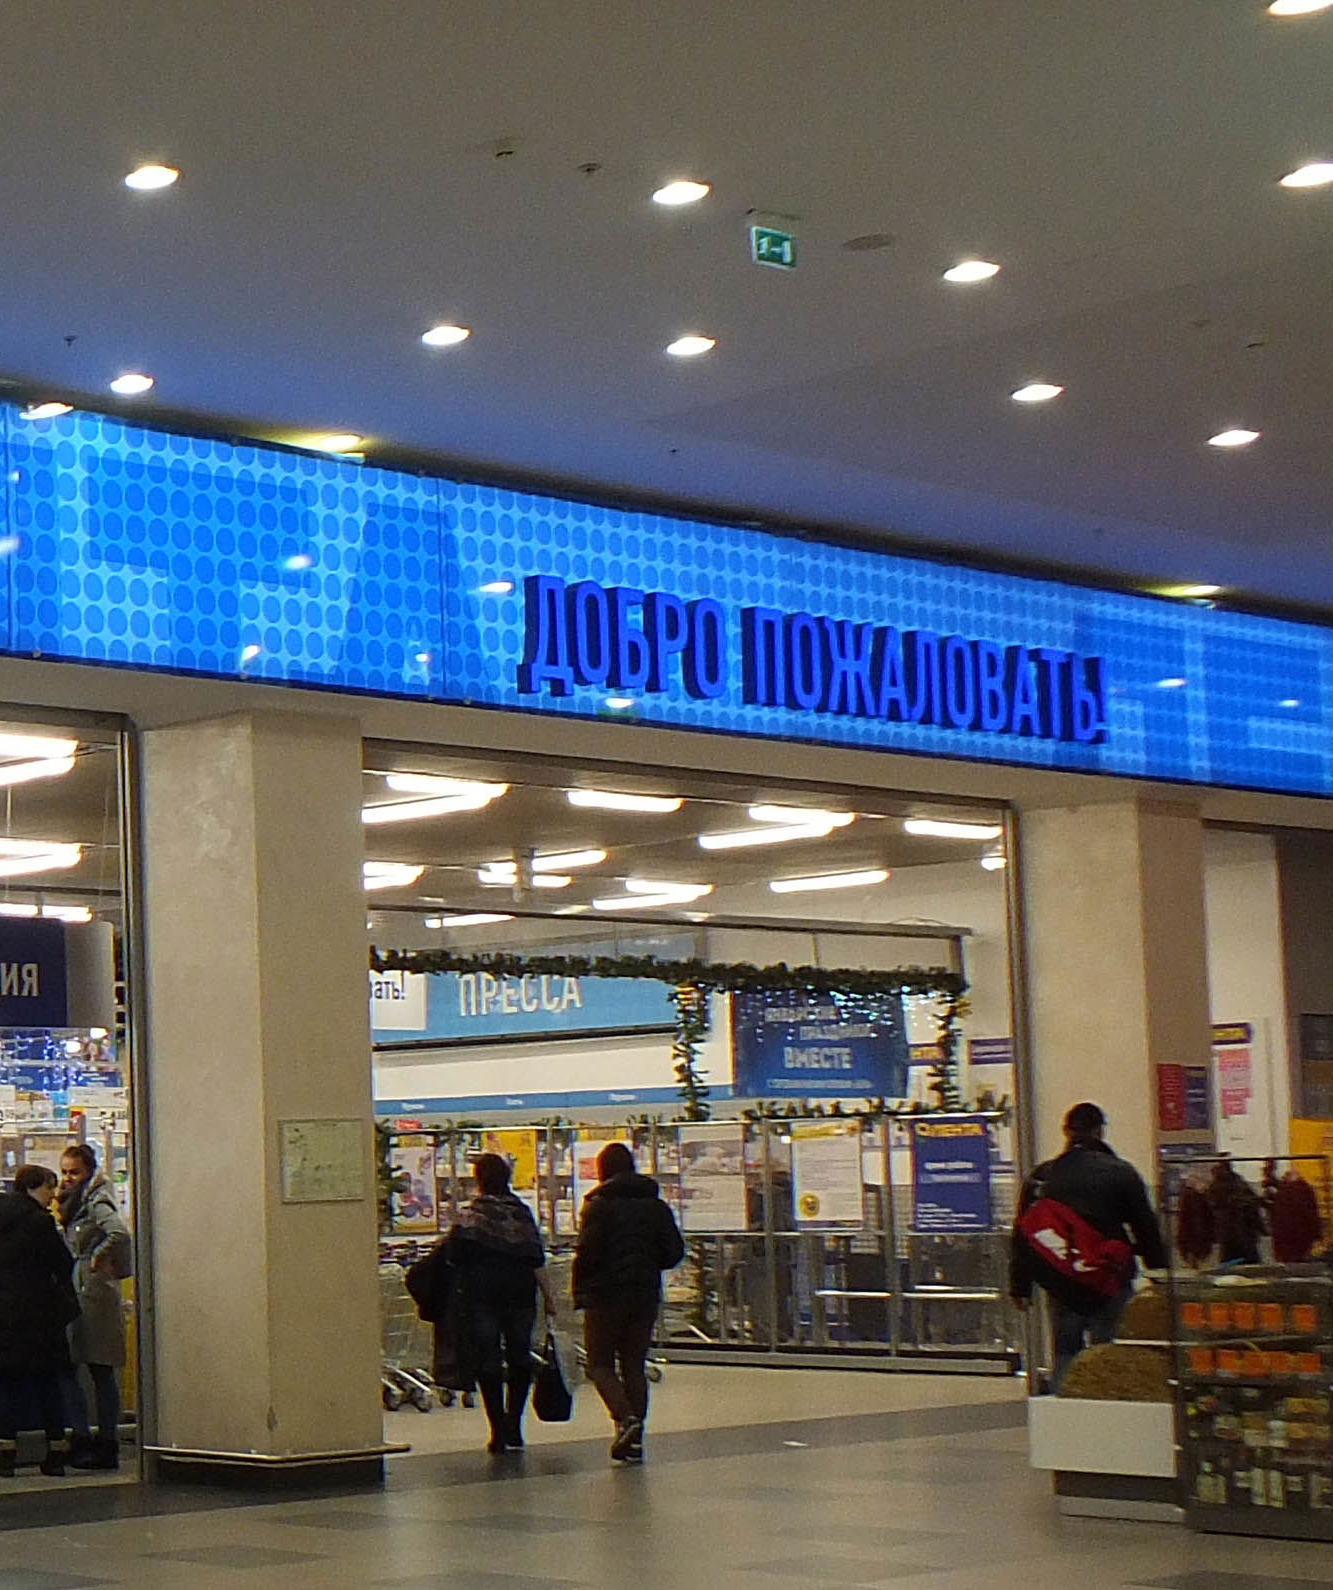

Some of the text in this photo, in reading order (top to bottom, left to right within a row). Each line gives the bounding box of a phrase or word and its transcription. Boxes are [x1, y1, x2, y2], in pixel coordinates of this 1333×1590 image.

[517, 575, 728, 700] ДОБРО
[741, 606, 1110, 744] ПОЖАЛОВАТЬ!
[370, 969, 405, 1000] ать!
[458, 971, 583, 1017] ПРЕССА
[783, 1046, 854, 1069] ВМЕСТЕ
